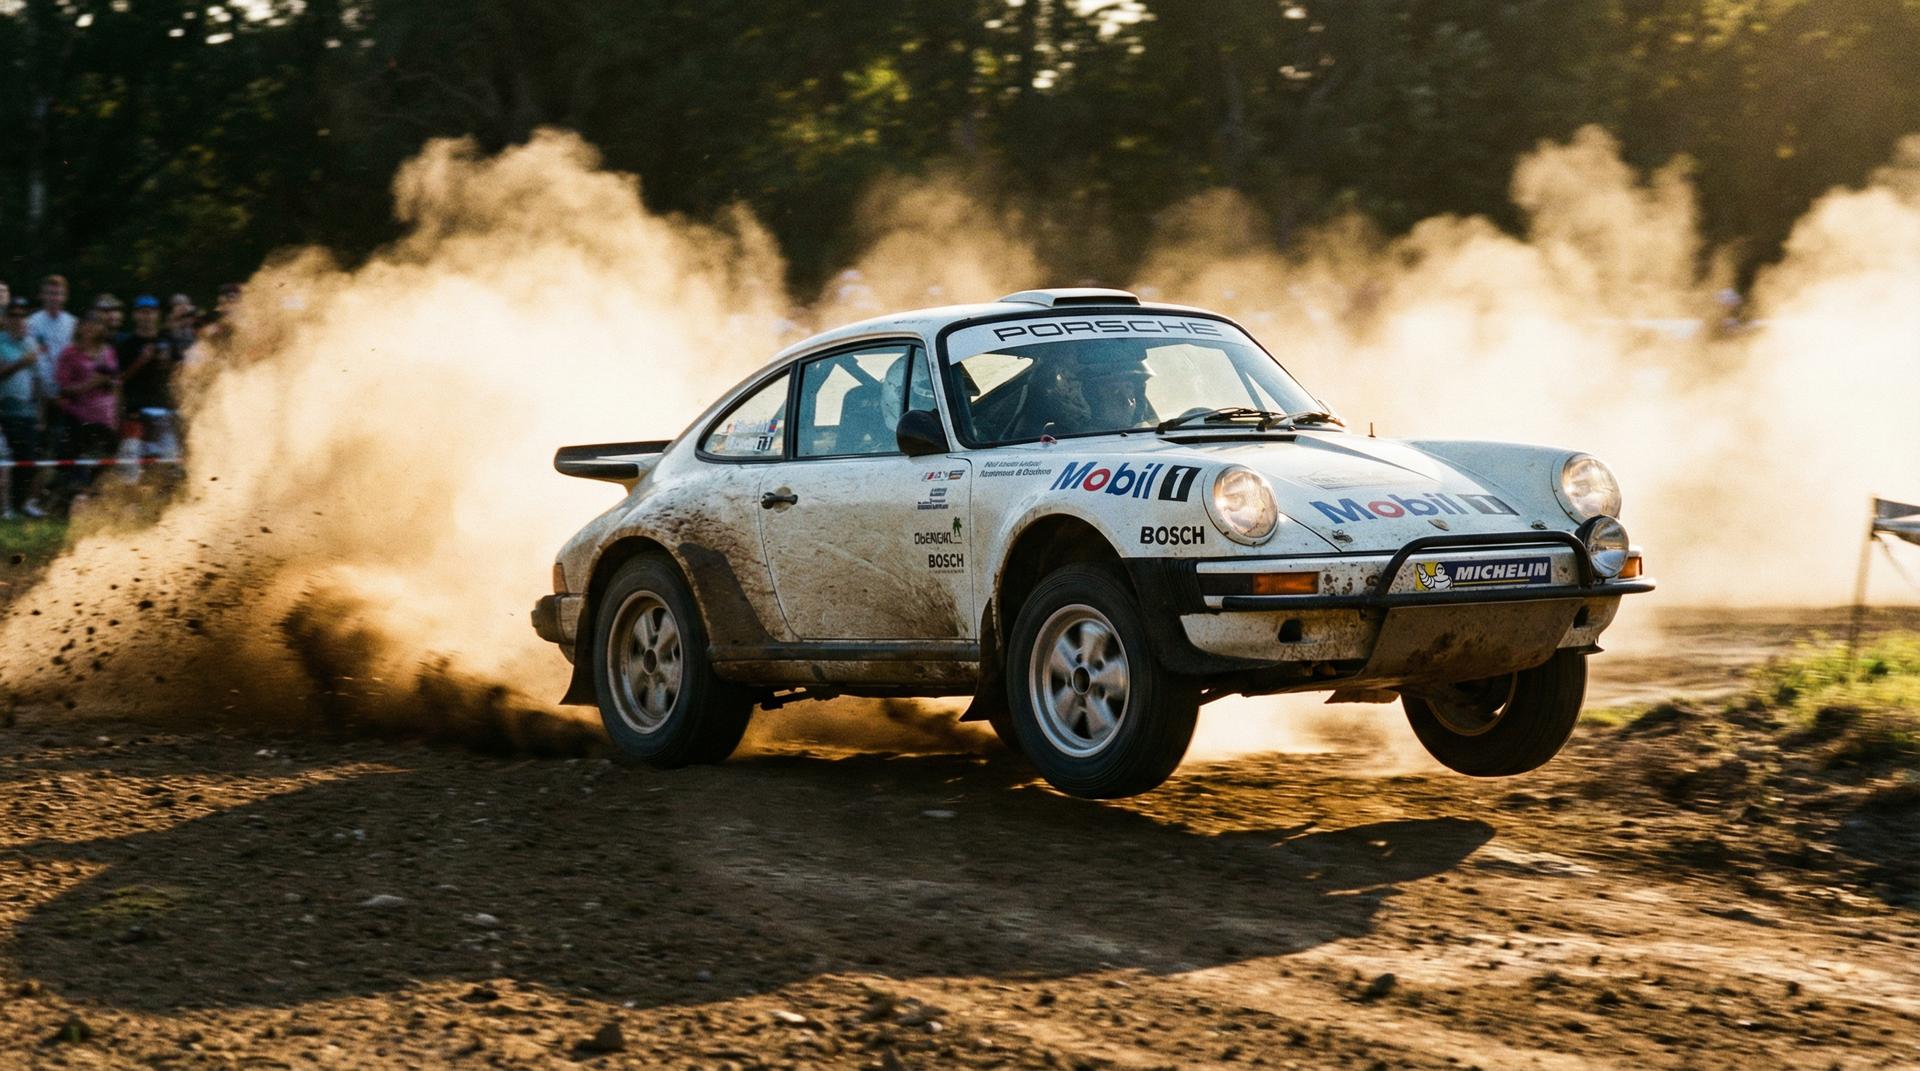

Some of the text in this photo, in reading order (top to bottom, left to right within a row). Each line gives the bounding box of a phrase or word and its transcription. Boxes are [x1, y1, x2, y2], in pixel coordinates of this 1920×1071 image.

[993, 320, 1221, 341] PORSCHE
[1050, 462, 1164, 499] Mobil
[1309, 493, 1469, 524] Mobil
[1140, 526, 1205, 545] BOSCH
[928, 553, 964, 568] BOSCH
[1455, 562, 1548, 580] MICHELIN
